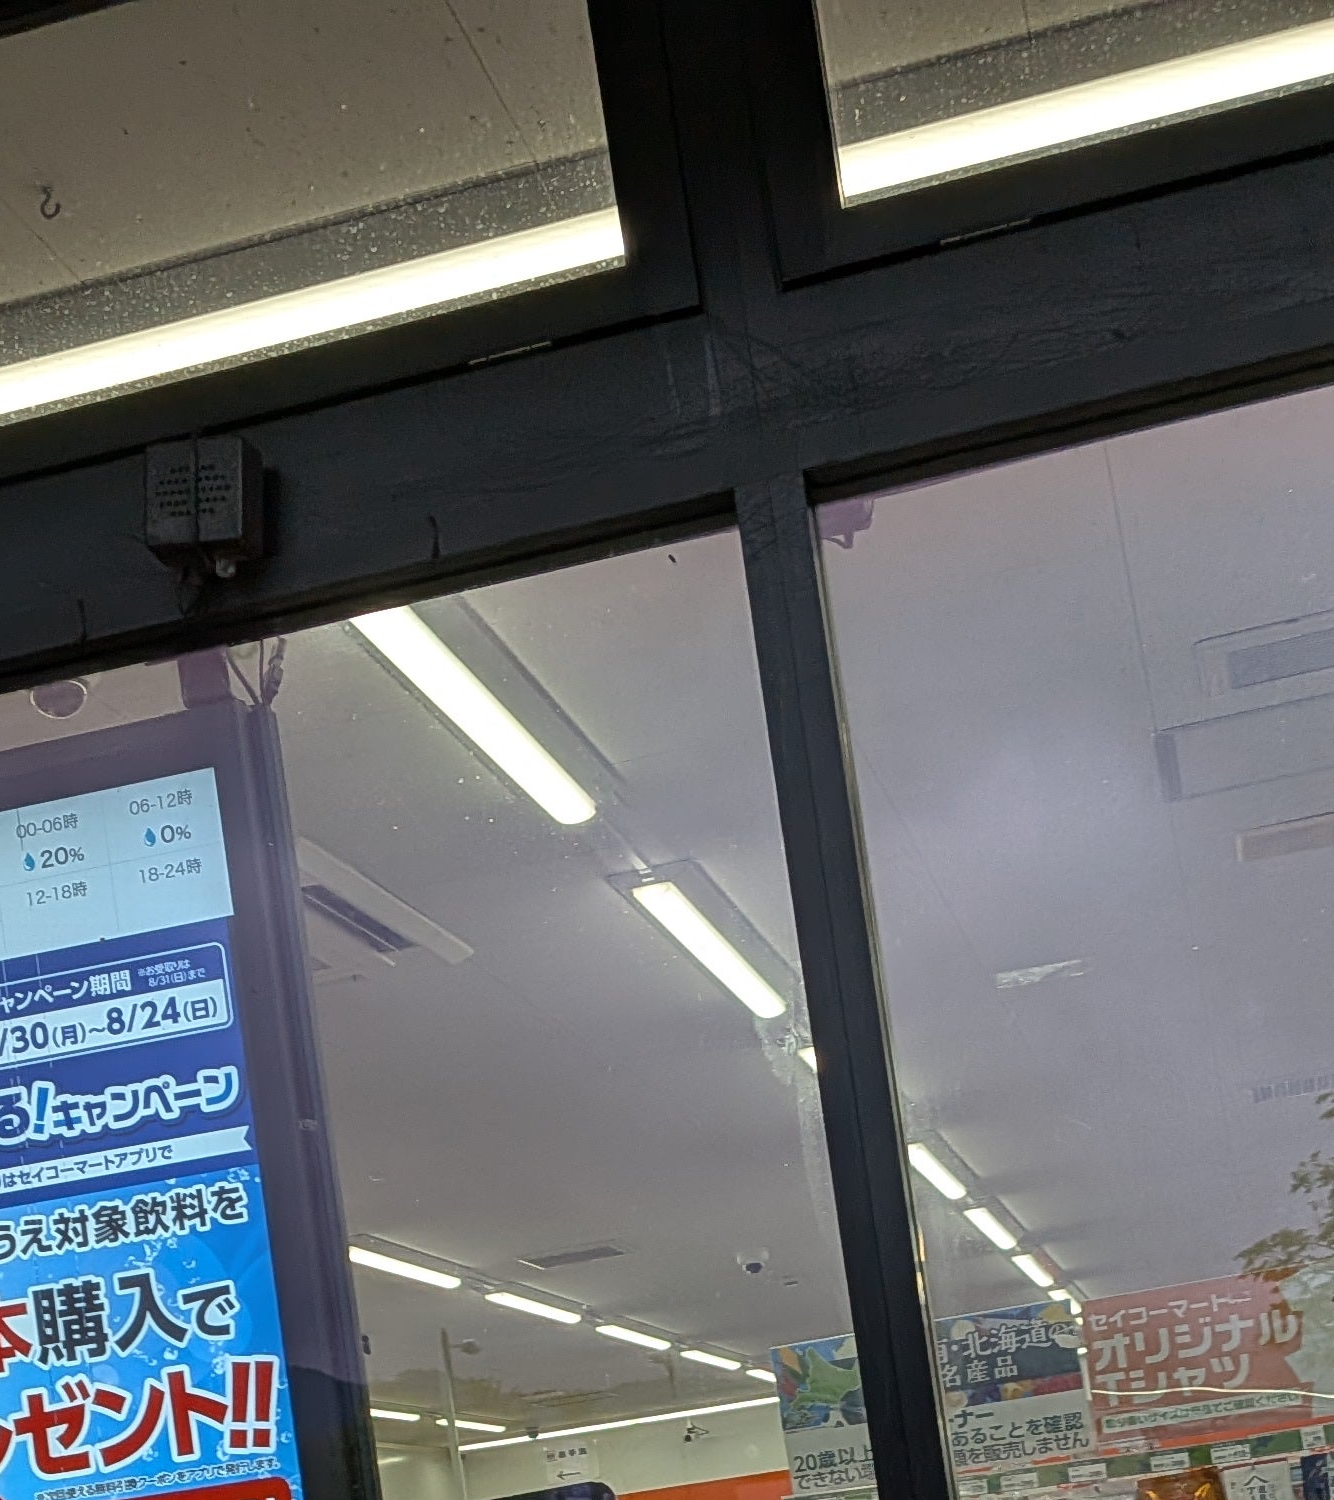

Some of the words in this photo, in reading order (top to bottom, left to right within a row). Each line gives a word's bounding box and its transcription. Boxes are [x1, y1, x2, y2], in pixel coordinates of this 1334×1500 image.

[129, 788, 193, 815] 06-12時
[16, 812, 79, 839] 00-06時
[160, 825, 192, 843] 0%
[40, 846, 85, 869] 20%
[140, 858, 202, 884] 18-24時
[26, 881, 88, 907] 12-18時
[1094, 1309, 1303, 1372] オリジナル
[939, 1355, 1018, 1388] 名産品
[1096, 1352, 1250, 1408] Tシャツ
[793, 1444, 874, 1473] 20歳以上
[951, 1411, 1084, 1447] あることを確認
